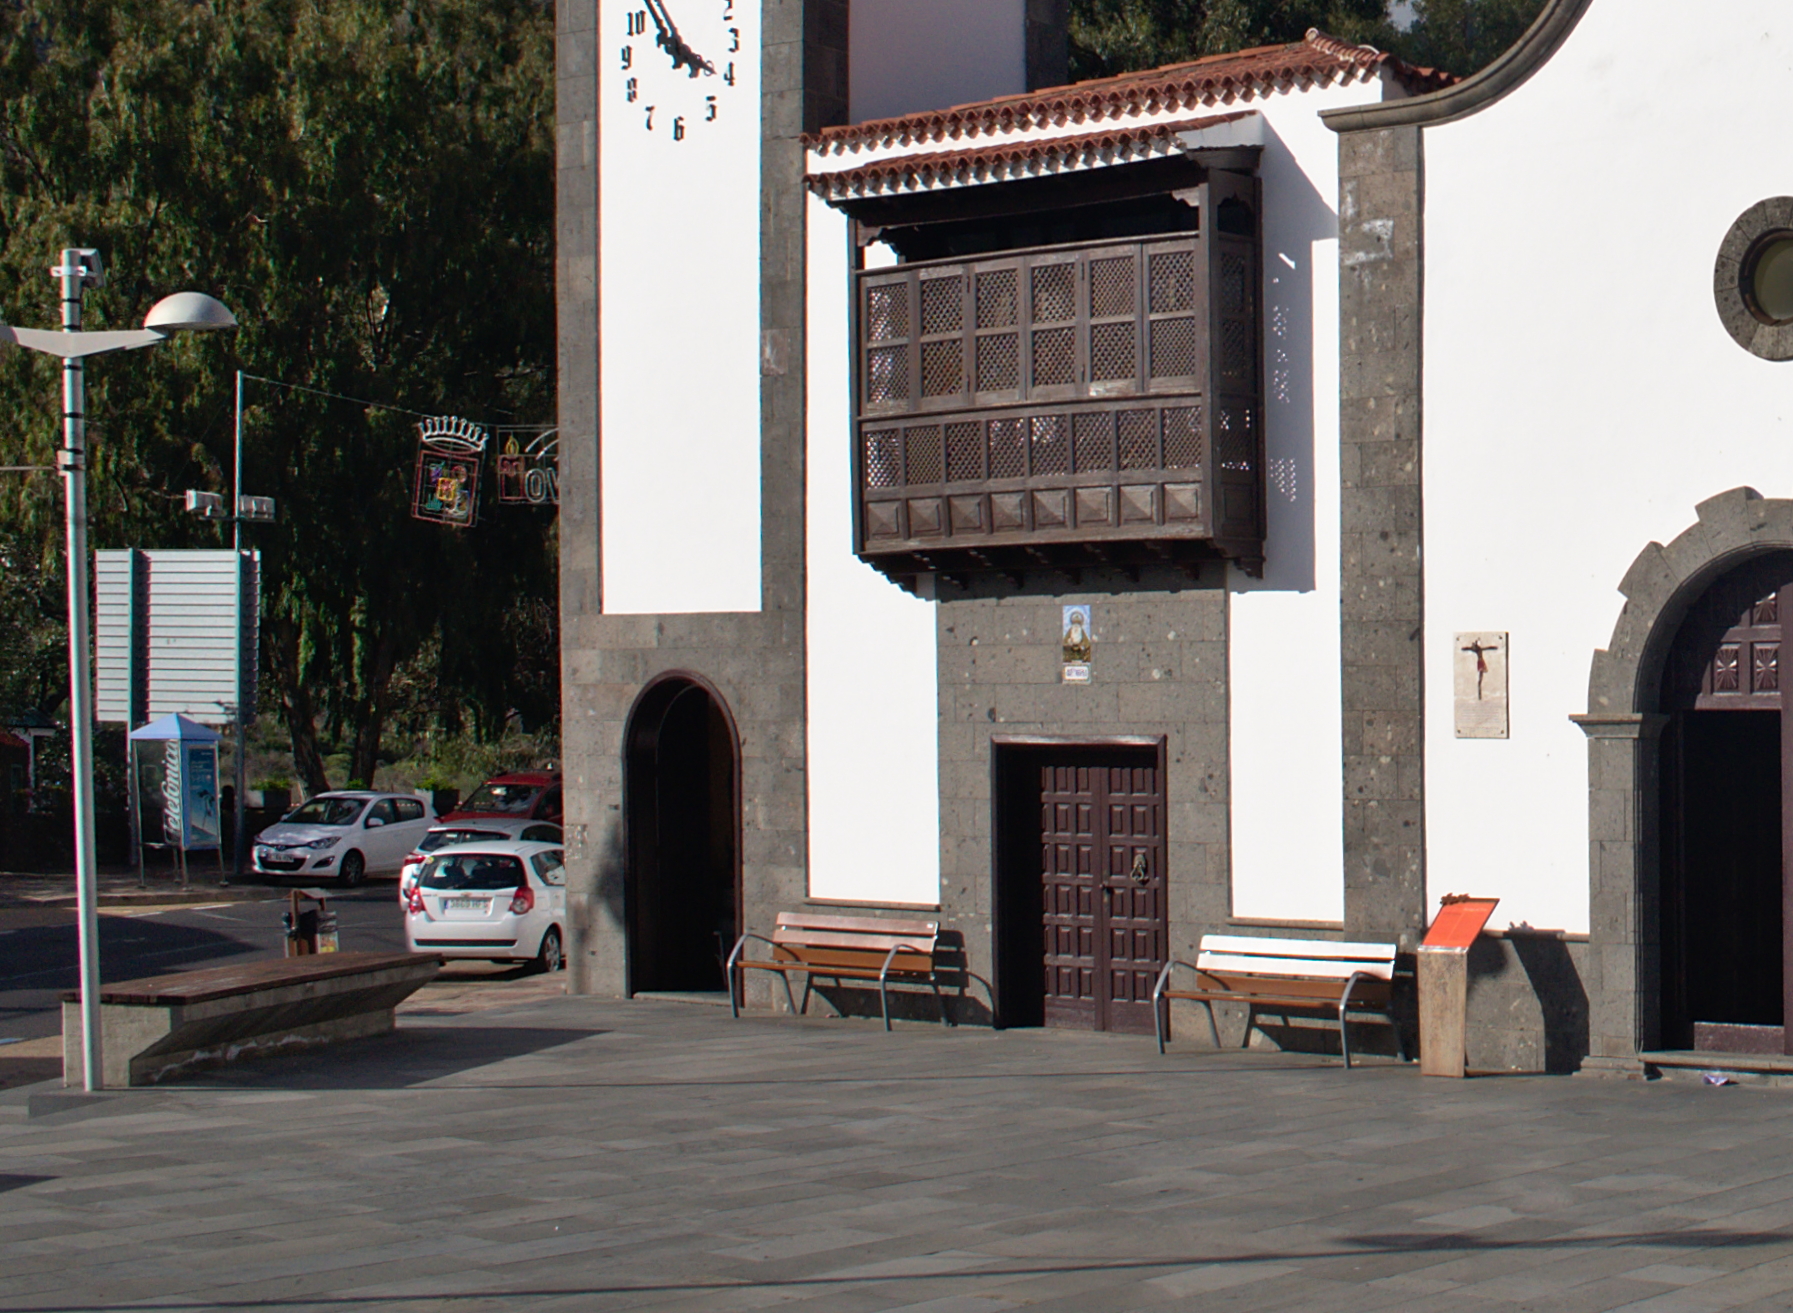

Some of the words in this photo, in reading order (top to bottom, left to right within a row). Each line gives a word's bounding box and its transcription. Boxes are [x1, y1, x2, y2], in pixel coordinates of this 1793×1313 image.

[626, 9, 647, 37] 10
[728, 27, 740, 54] 3
[621, 45, 633, 71] 9
[723, 61, 736, 87] 4
[626, 77, 638, 103] 8
[645, 105, 656, 132] 7
[705, 95, 717, 122] 5
[673, 115, 685, 142] 6
